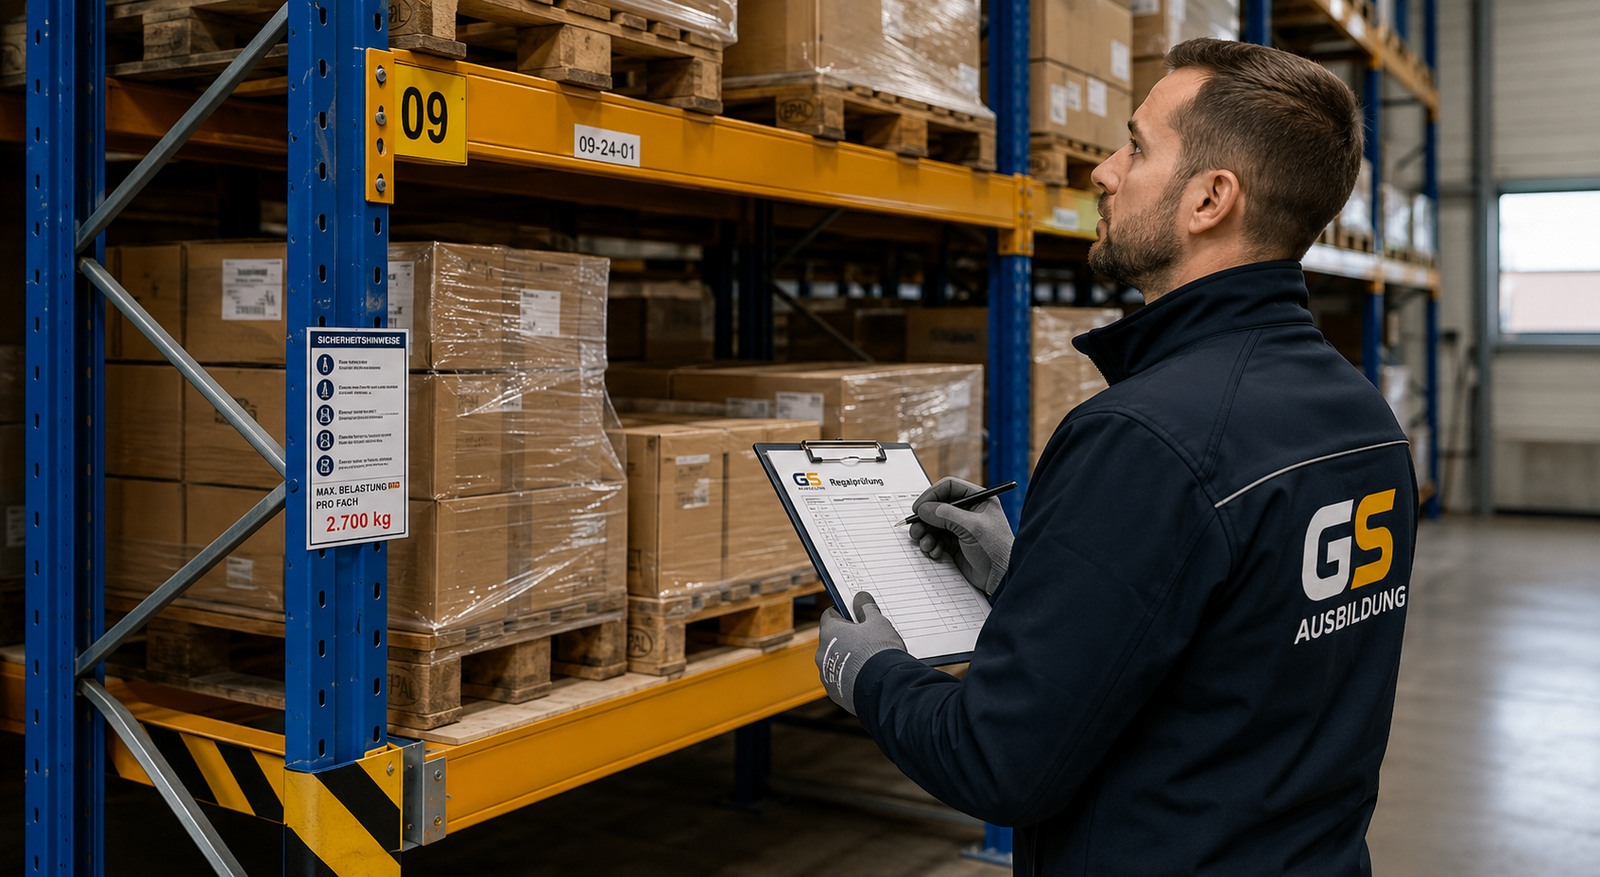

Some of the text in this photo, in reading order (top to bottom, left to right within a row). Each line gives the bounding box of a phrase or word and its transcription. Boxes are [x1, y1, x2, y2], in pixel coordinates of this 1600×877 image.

[402, 86, 448, 144] 09
[579, 135, 635, 160] 09-24-01
[317, 335, 400, 345] SICHERHEITSHINWEISE
[316, 487, 337, 496] MAX.
[339, 483, 387, 495] BELASTUNG
[792, 472, 822, 486] GS
[829, 477, 884, 488] Regalprüfung
[316, 497, 359, 509] PRO FACH
[326, 511, 391, 532] 2.700 kg
[1302, 488, 1396, 602] GS
[1294, 585, 1406, 645] AUSBILDUNG
[388, 673, 416, 700] PAL
